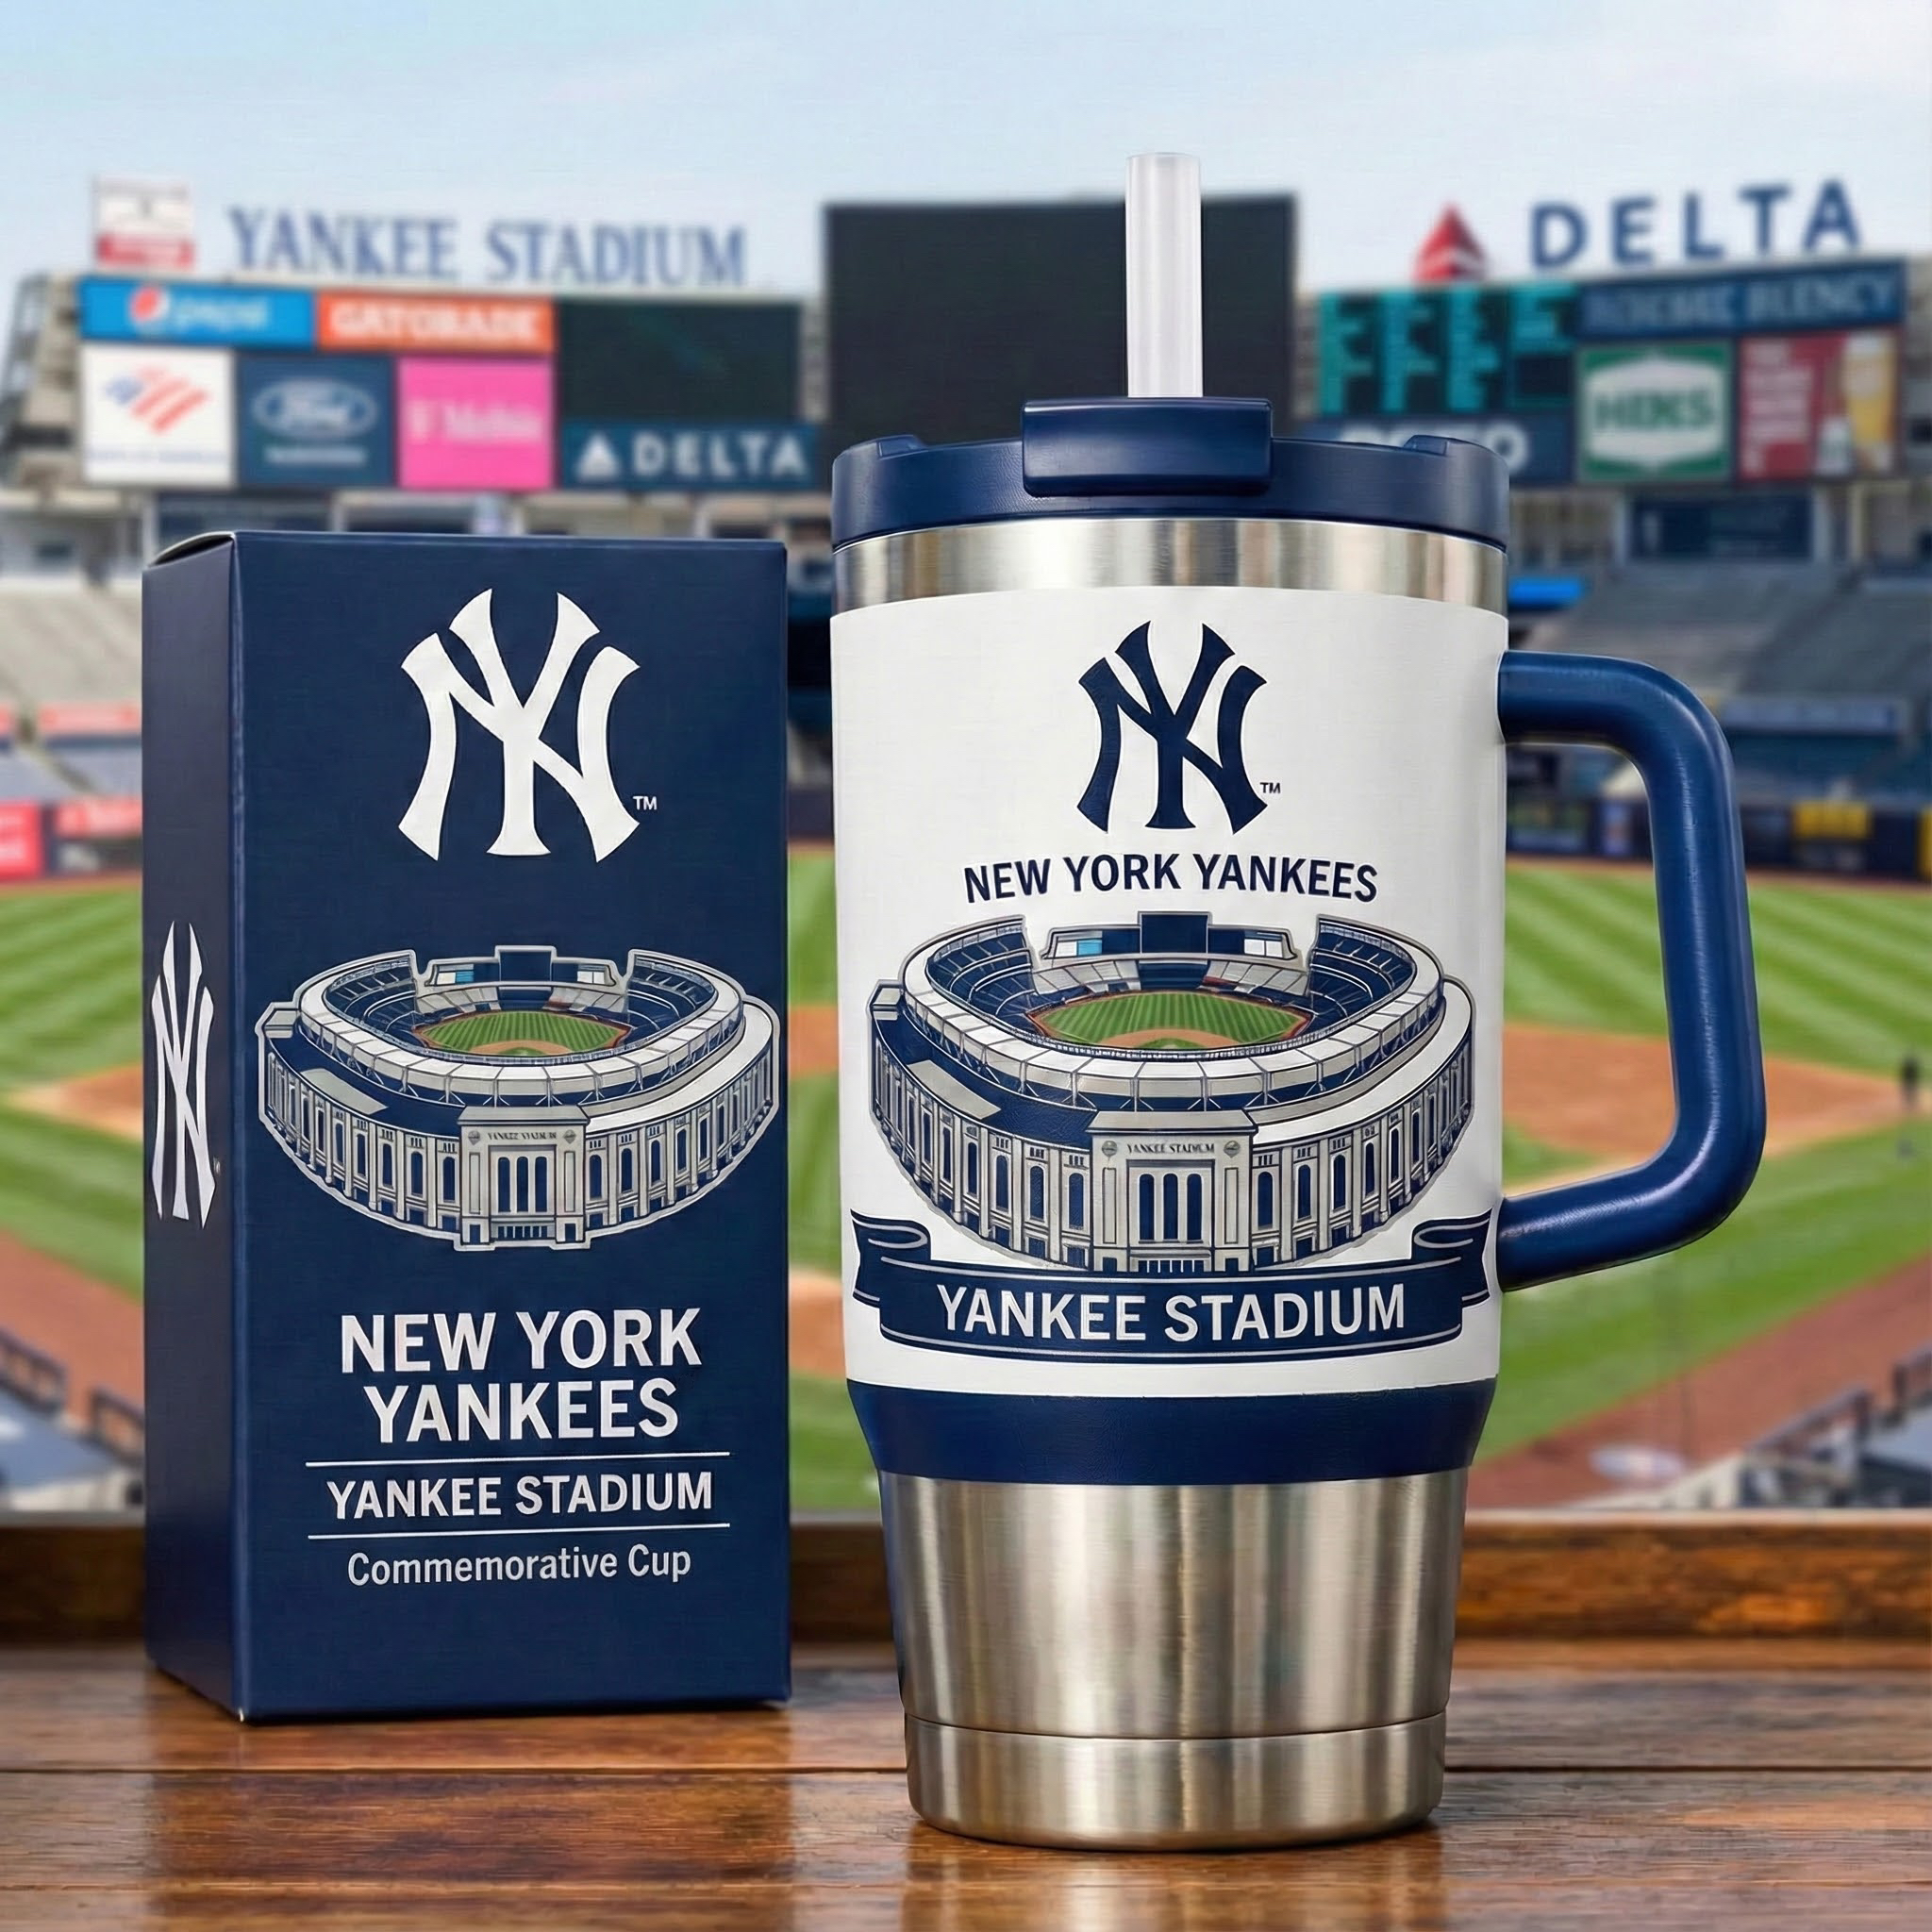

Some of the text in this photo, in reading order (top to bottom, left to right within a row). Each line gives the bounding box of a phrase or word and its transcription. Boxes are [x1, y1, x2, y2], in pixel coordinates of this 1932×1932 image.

[228, 205, 746, 286] YANKEE STADIUM
[1530, 177, 1863, 269] DELTA
[633, 431, 808, 479] DELTA
[964, 853, 1378, 904] NEW YORK YANKEES
[1126, 1143, 1167, 1154] YANKEE
[937, 1283, 1406, 1342] YANKEE STADIUM
[341, 1307, 703, 1374] NEW YORK
[363, 1377, 678, 1443] YANKEES
[326, 1471, 712, 1520] YANKEE STADIUM
[347, 1543, 691, 1587] Commemorative Cup
